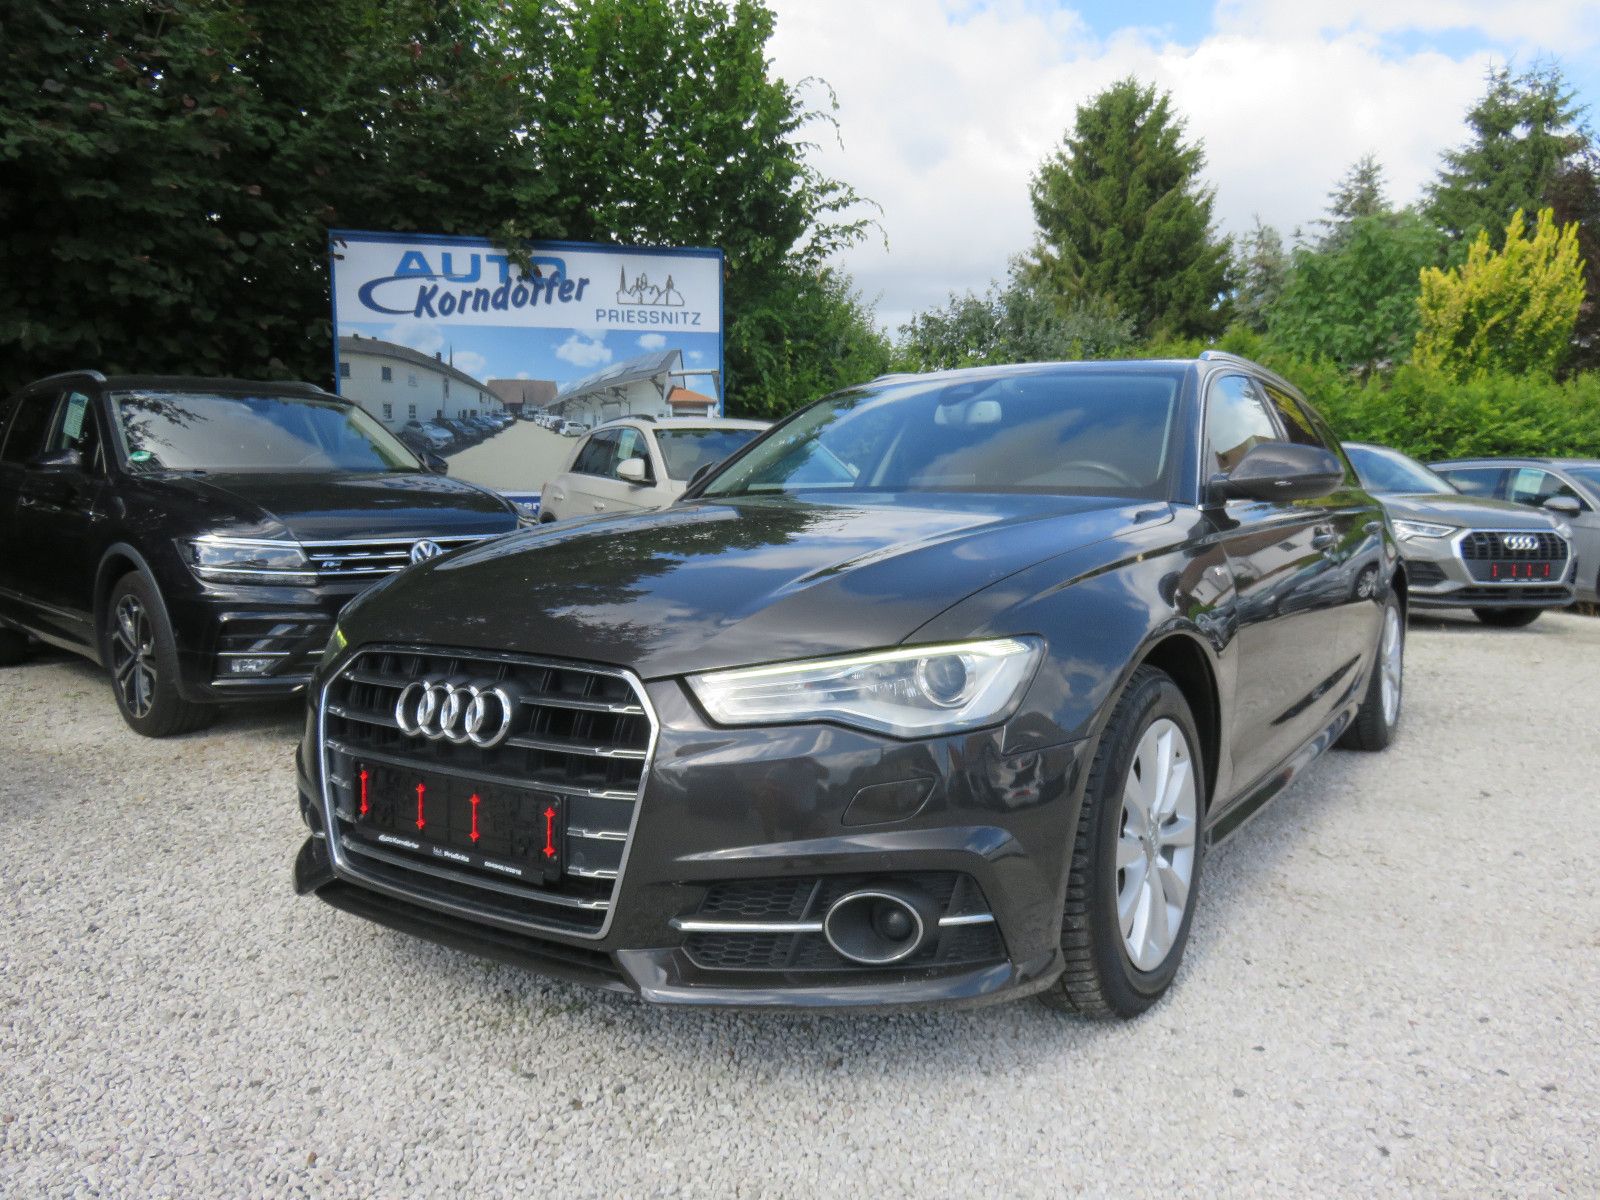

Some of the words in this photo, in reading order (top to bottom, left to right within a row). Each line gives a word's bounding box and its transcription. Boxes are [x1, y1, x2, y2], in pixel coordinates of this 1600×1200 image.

[394, 250, 567, 286] AUTO
[414, 270, 590, 318] Korndörfer
[595, 308, 701, 326] PRIESSNITZ
